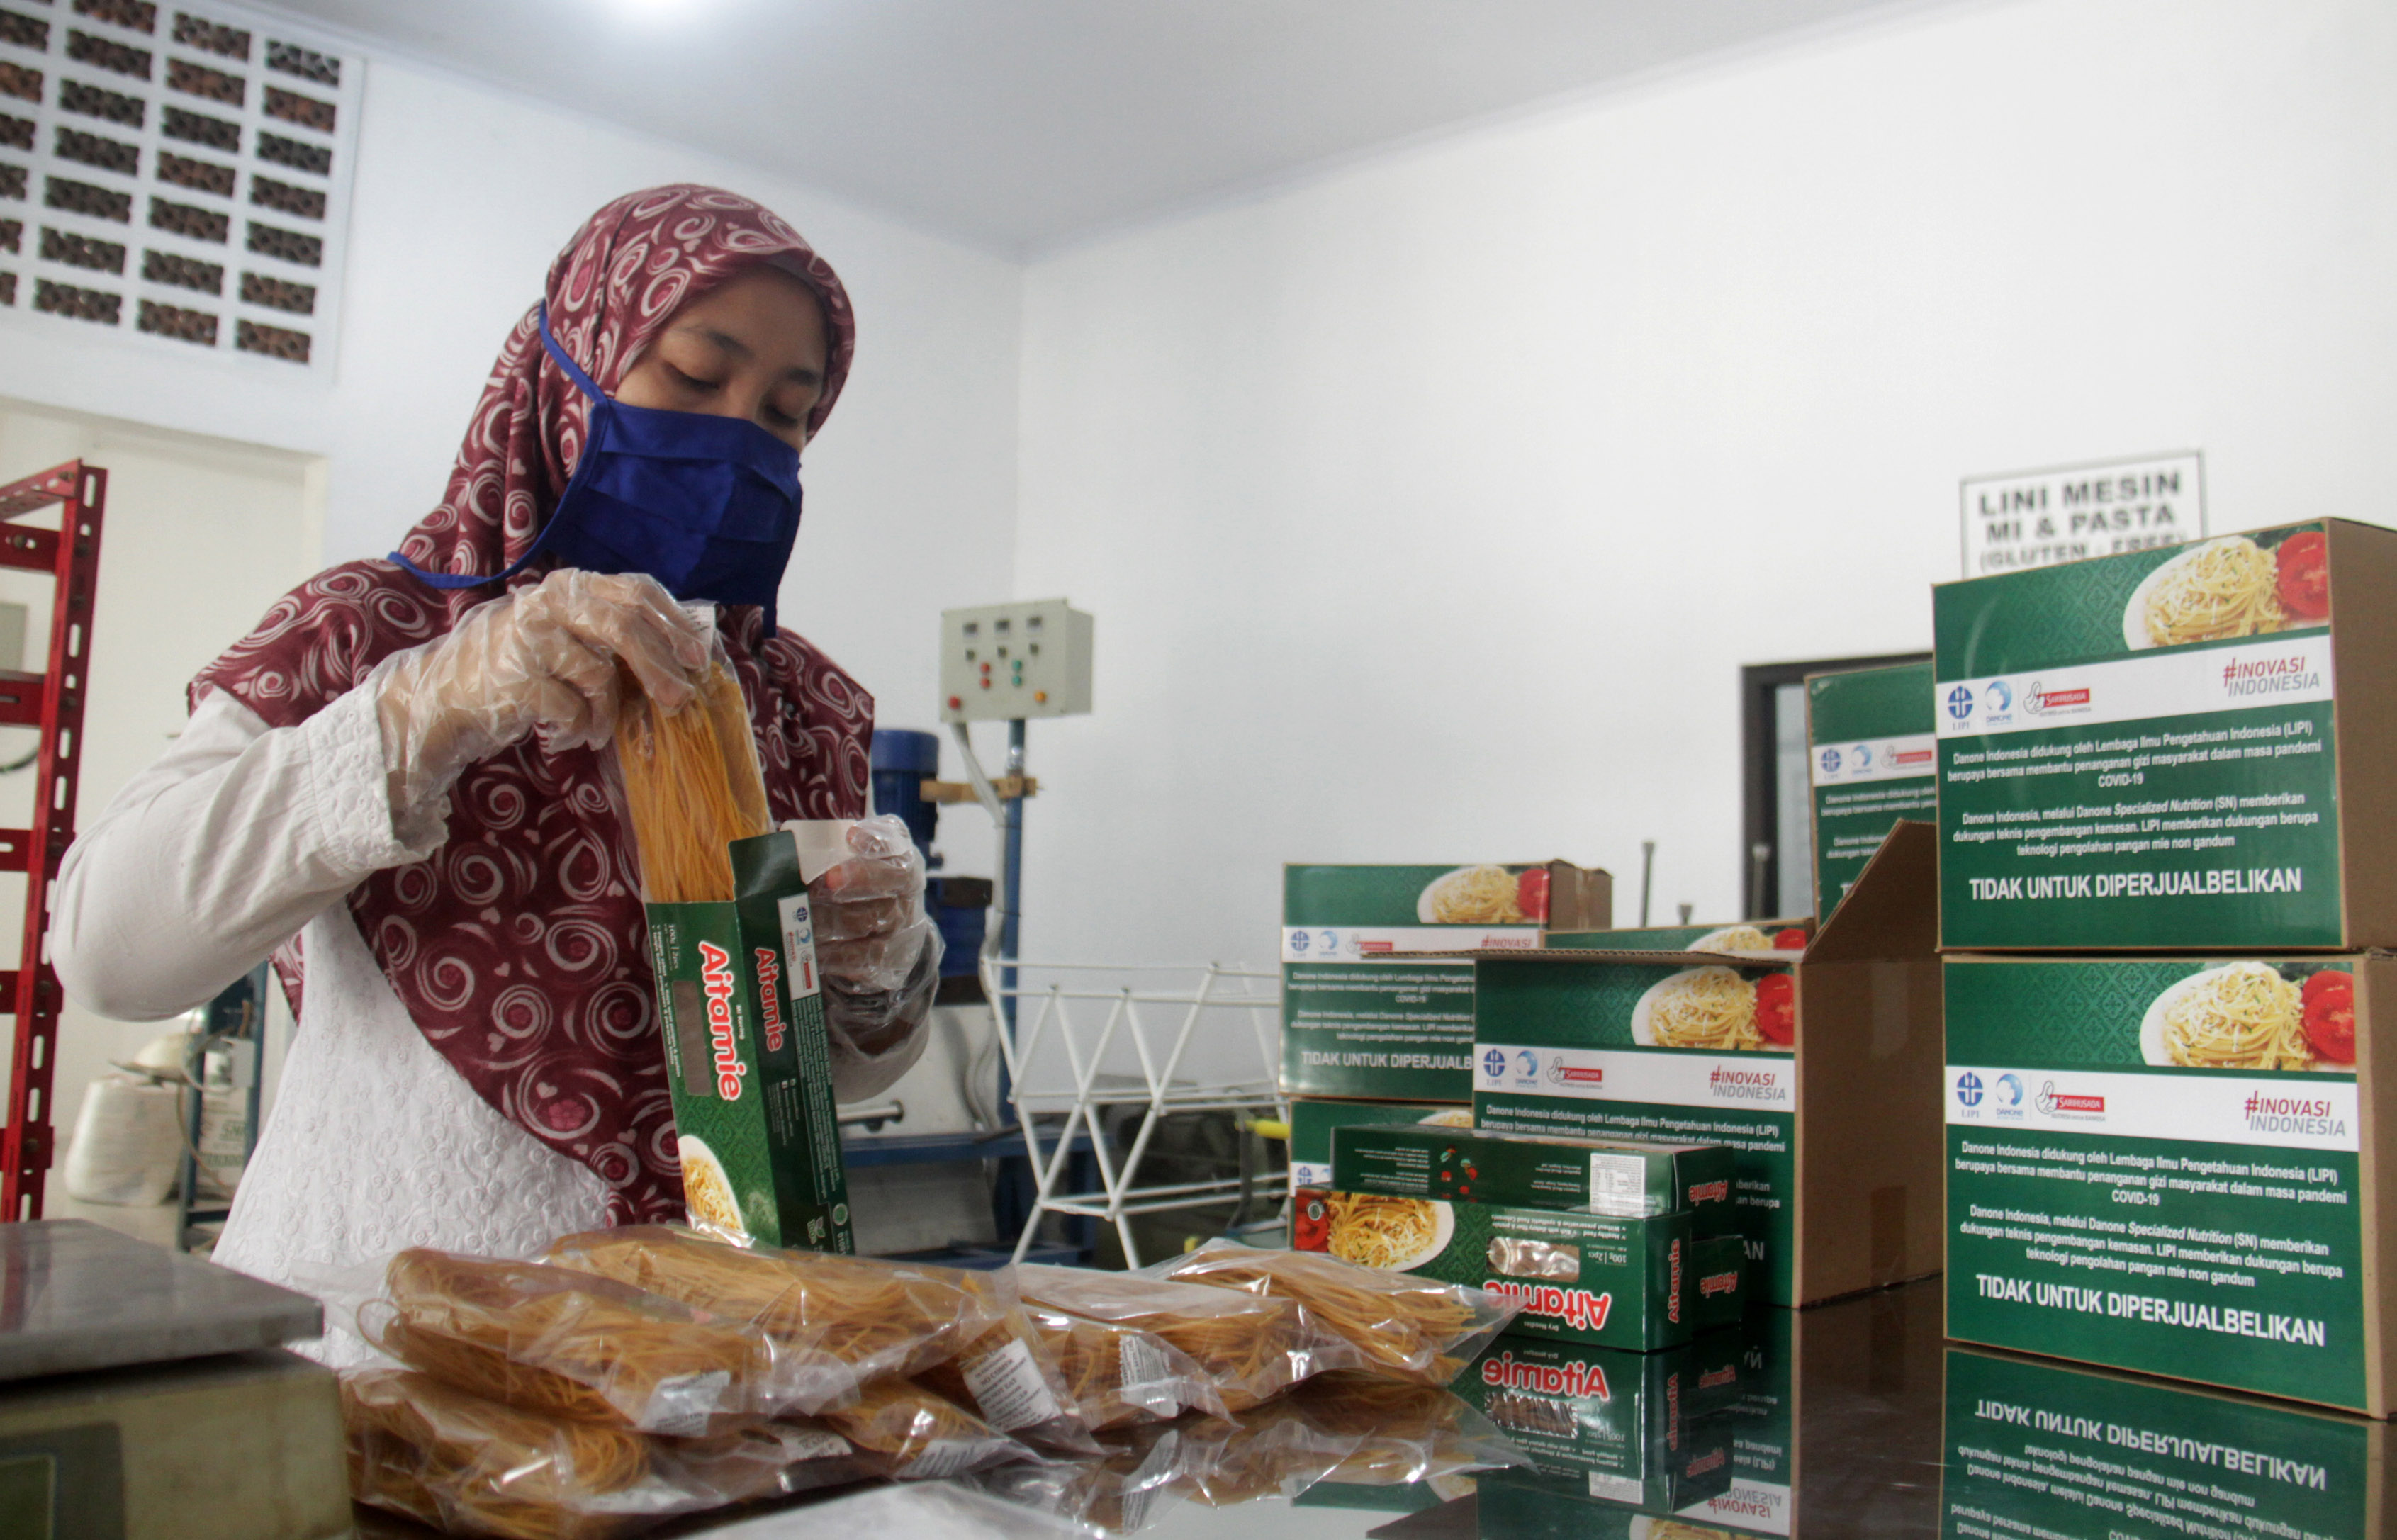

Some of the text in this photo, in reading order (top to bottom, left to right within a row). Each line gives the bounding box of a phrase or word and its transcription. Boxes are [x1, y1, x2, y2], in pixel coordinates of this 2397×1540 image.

[1978, 471, 2181, 516] LINI MESIN
[1986, 504, 2174, 544] MI & PASTA
[2223, 656, 2305, 688] #INOVASI
[2228, 673, 2320, 697] INDONESIA
[1953, 721, 1970, 731] LIPI
[1954, 720, 2313, 764] Danone Indonesia didukung oleh Lembaga Ilmu Pengetahuan Indonesia (LIPI)
[1948, 739, 2323, 782] berupaya bersama membantu penanganan gizi masyarakat dalam masa pandemi
[2098, 772, 2144, 787] COVID-19
[1963, 792, 2306, 824] Danone Indonesia, melalui Danone Specialized Nutrition (SN) memberikan
[1953, 811, 2319, 843] dukungan teknis pengembangan kemasan. LIPI memberikan dukungan berupa
[2017, 835, 2235, 857] teknologi pengolahan pangan mie non gandum
[1970, 868, 2302, 899] TIDAK UNTUK DIPERJUALBELIKAN
[755, 947, 787, 1052] Aitamie
[698, 940, 747, 1101] Aitamie
[1301, 1052, 1340, 1066] TIDAK
[1343, 1053, 1388, 1067] UNTUK
[1710, 1065, 1775, 1089] #INOVASI
[1714, 1084, 1787, 1101] INDONESIA
[1487, 1105, 1779, 1137] Danone Indonesia didukung oleh Lembaga Ilmu Pengetahuan Indonesia (LIPI)
[1961, 1110, 1980, 1119] LIPI
[2245, 1090, 2331, 1120] #INOVASI
[2250, 1115, 2346, 1137] INDONESIA
[1962, 1141, 2337, 1185] Danone Indonesia didukung oleh Lembaga Ilmu Pengetahuan Indonesia (LIPI)
[1689, 1179, 1728, 1206] Aitamie
[1736, 1179, 1771, 1191] berikan
[1955, 1159, 2347, 1203] berupaya bersama membantu penanganan gizi masyarakat dalam masa pandemi
[2112, 1190, 2160, 1206] COVID-19
[1970, 1205, 2329, 1255] Danone Indonesia, melalui Danone Specialized Nutrition (SN) memberikan
[1960, 1222, 2343, 1278] dukungan teknis pengembangan kemasan. LIPI memberikan dukungan berupa
[1668, 1237, 1680, 1324] Aitamie
[2026, 1248, 2255, 1286] teknologi pengolahan pangan mie non gandum
[1700, 1270, 1738, 1298] Aitamie
[1483, 1279, 1612, 1332] Aitamie
[1977, 1275, 2324, 1344] TIDAK UNTUK DIPERJUALBELIKAN
